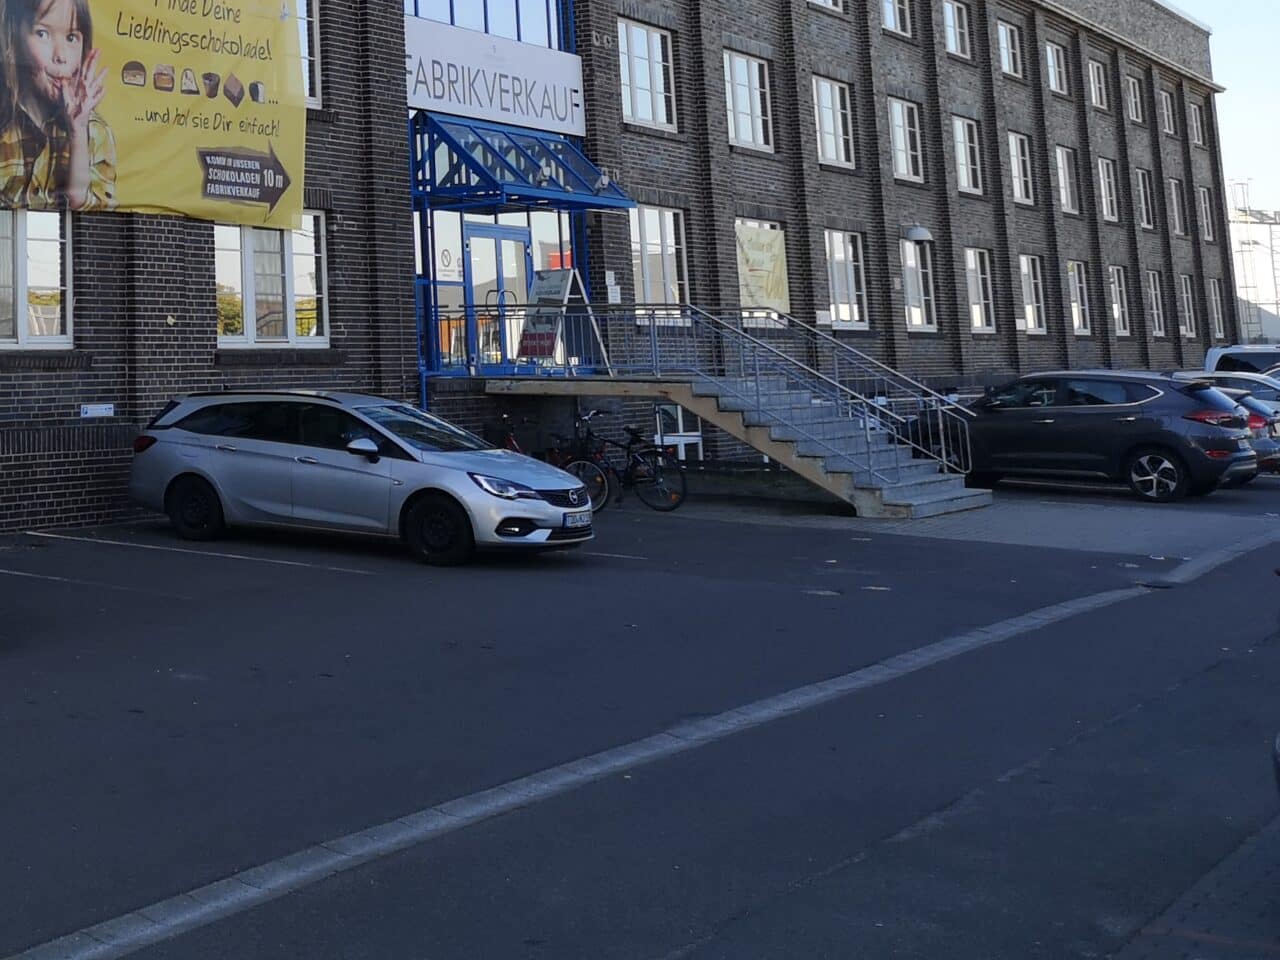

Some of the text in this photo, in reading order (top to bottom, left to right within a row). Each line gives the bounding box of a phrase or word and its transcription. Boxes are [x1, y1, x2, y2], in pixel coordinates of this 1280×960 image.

[116, 11, 272, 60] Lieblingsschokolade!
[192, 112, 209, 130] sie
[213, 113, 232, 132] Dir
[239, 116, 280, 138] einfach!
[207, 167, 261, 185] SCHOKOLADEN
[263, 169, 283, 188] 10 m
[206, 183, 261, 199] FABRIKVERKAUF
